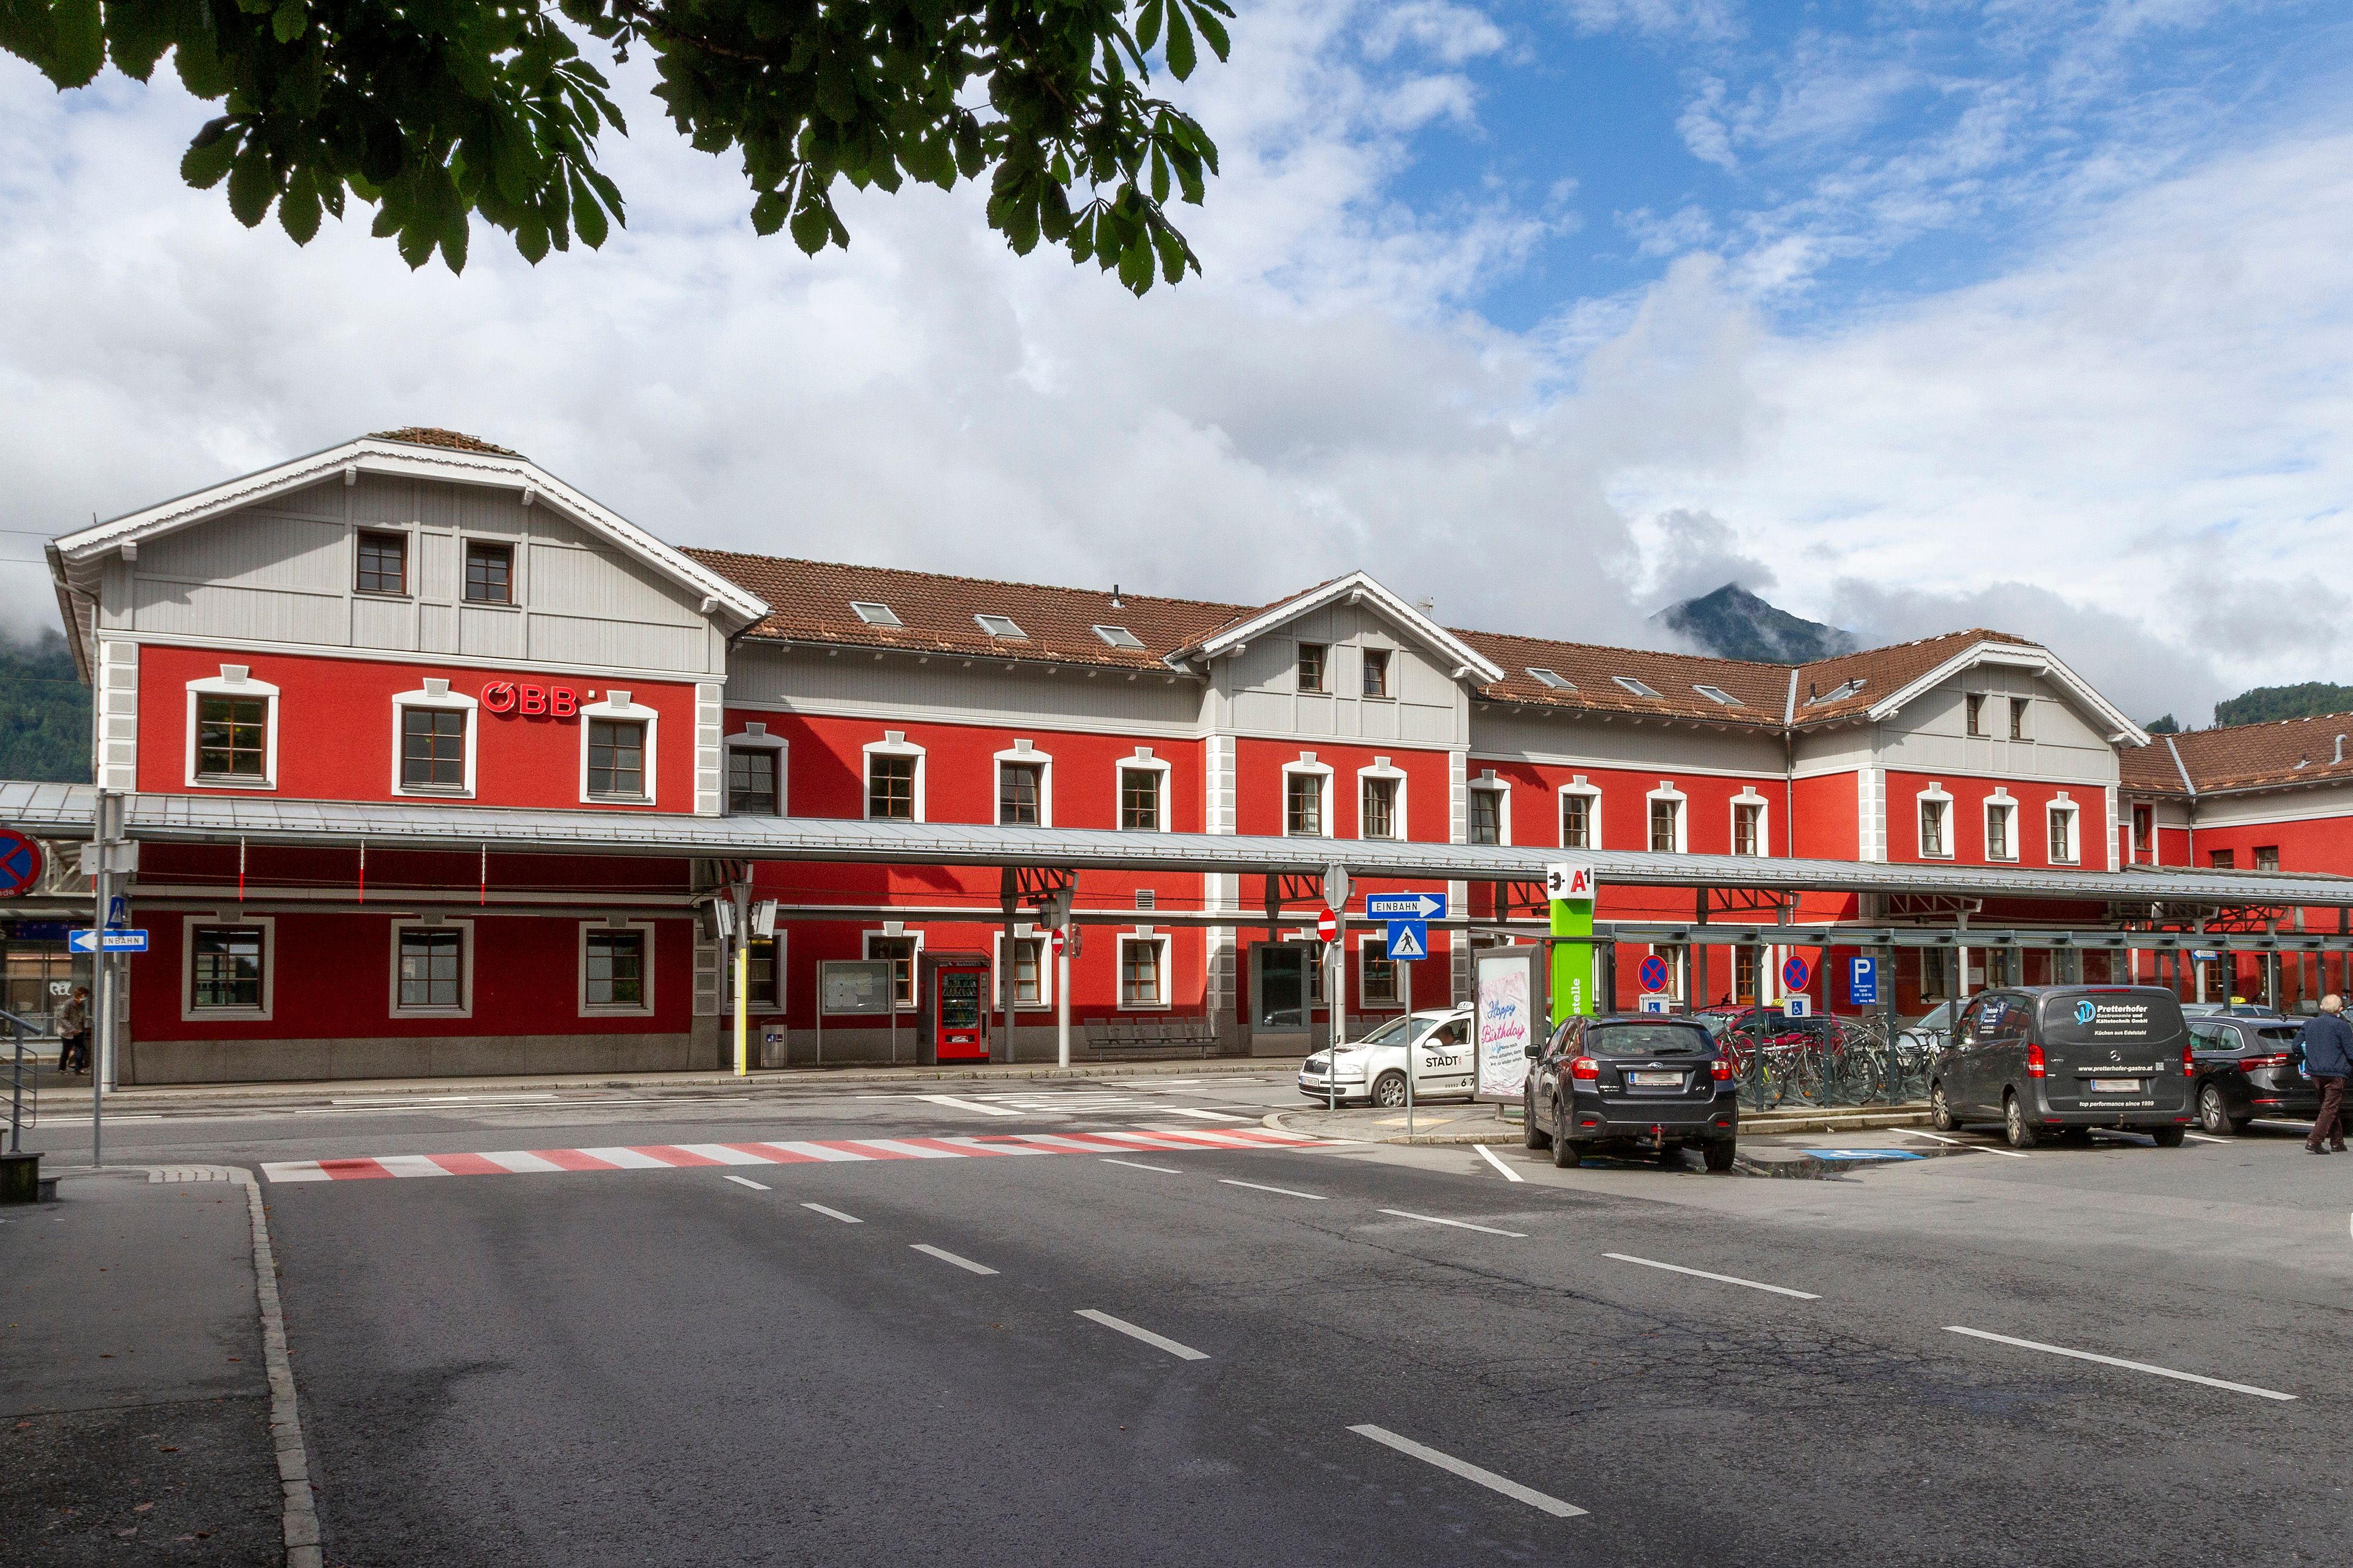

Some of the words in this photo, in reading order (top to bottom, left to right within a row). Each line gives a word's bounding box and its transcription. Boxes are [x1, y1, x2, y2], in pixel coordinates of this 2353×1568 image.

[1377, 902, 1417, 910] EINBAHN
[1855, 959, 1871, 983] P
[1571, 978, 1581, 1014] stelle
[1487, 999, 1516, 1020] Happy
[1481, 1019, 1525, 1044] Birthday
[1426, 1056, 1458, 1067] STADT
